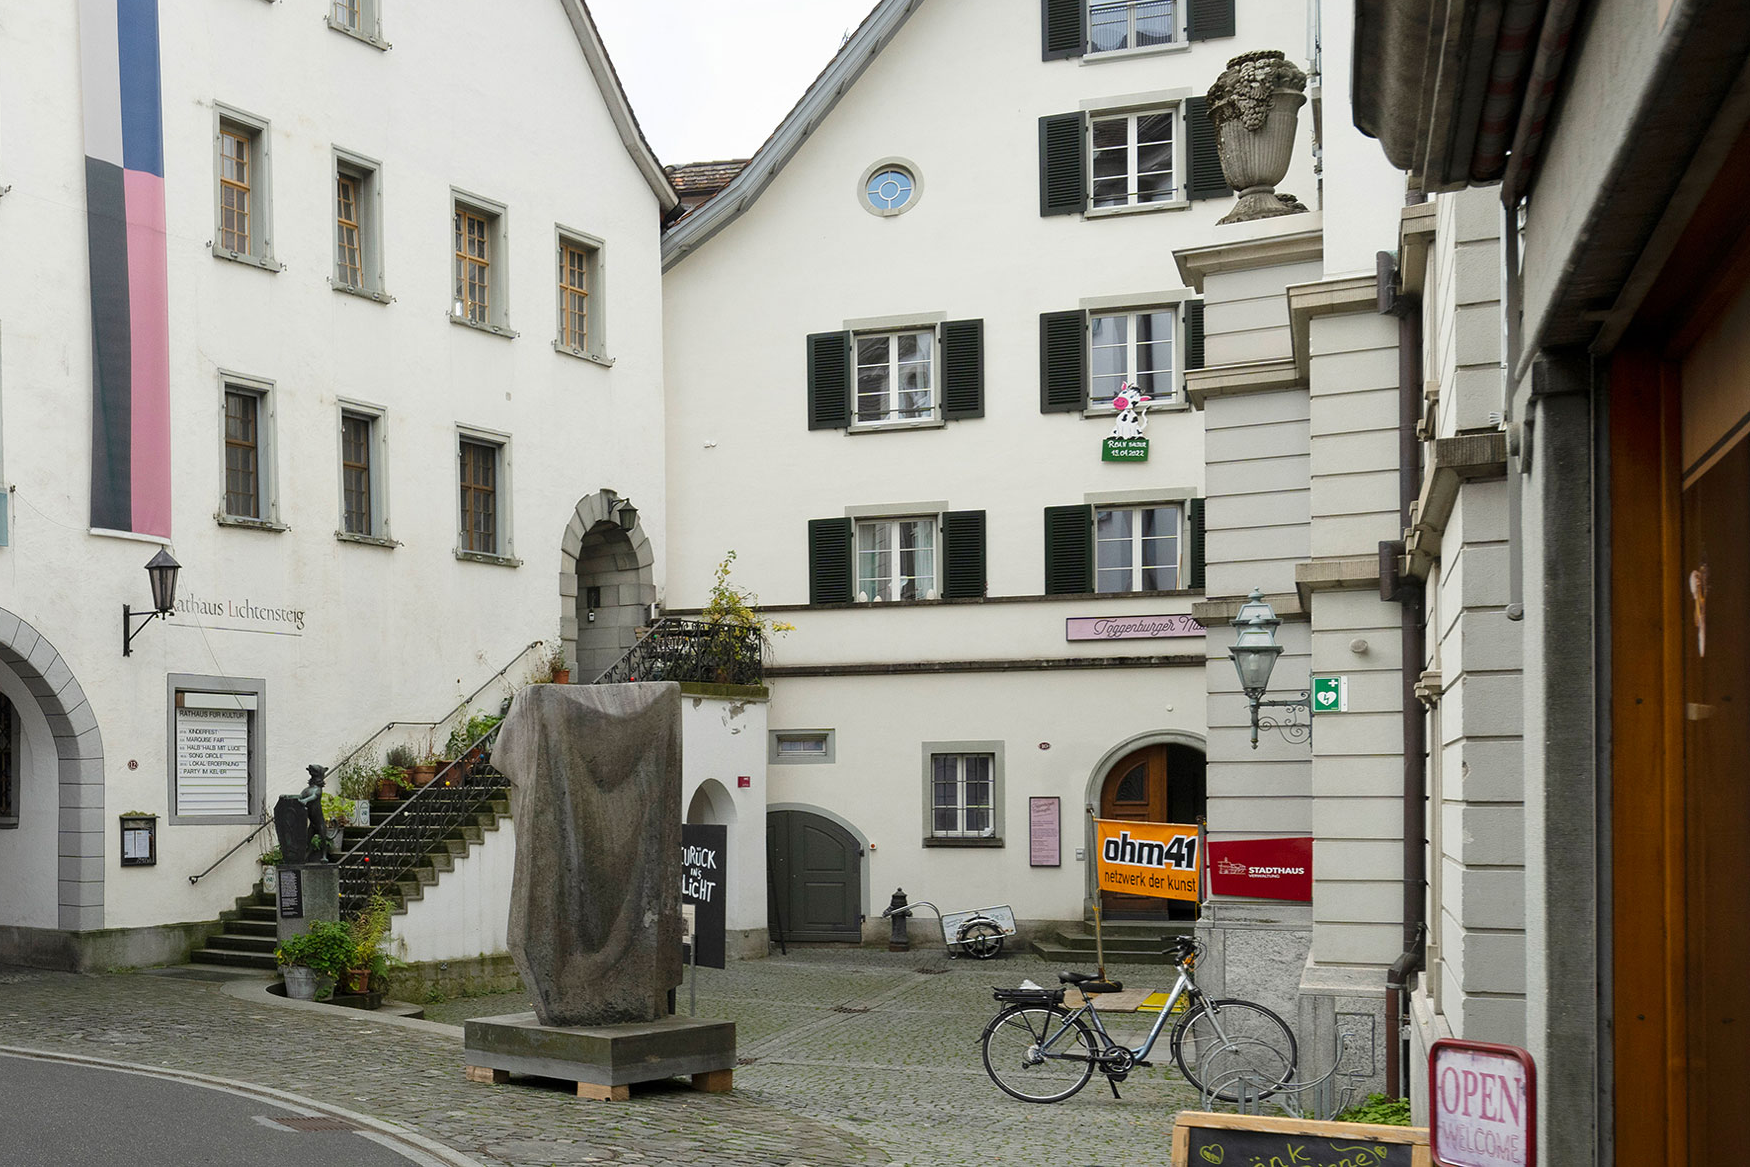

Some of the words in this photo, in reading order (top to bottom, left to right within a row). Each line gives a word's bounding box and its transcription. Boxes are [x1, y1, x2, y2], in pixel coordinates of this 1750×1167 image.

[228, 598, 306, 631] Lichtensteig
[1093, 618, 1175, 638] Toggenburger
[179, 710, 208, 718] RATHAUS
[222, 711, 245, 720] KULTUR
[681, 845, 717, 870] URÜCK
[1103, 831, 1198, 872] ohm41
[1104, 870, 1146, 888] netzwerk
[1149, 874, 1164, 889] der
[1167, 875, 1196, 893] kunst
[1248, 866, 1304, 875] STADTHAUS
[1441, 1066, 1521, 1128] OPEN
[1440, 1121, 1521, 1164] WELCOME
